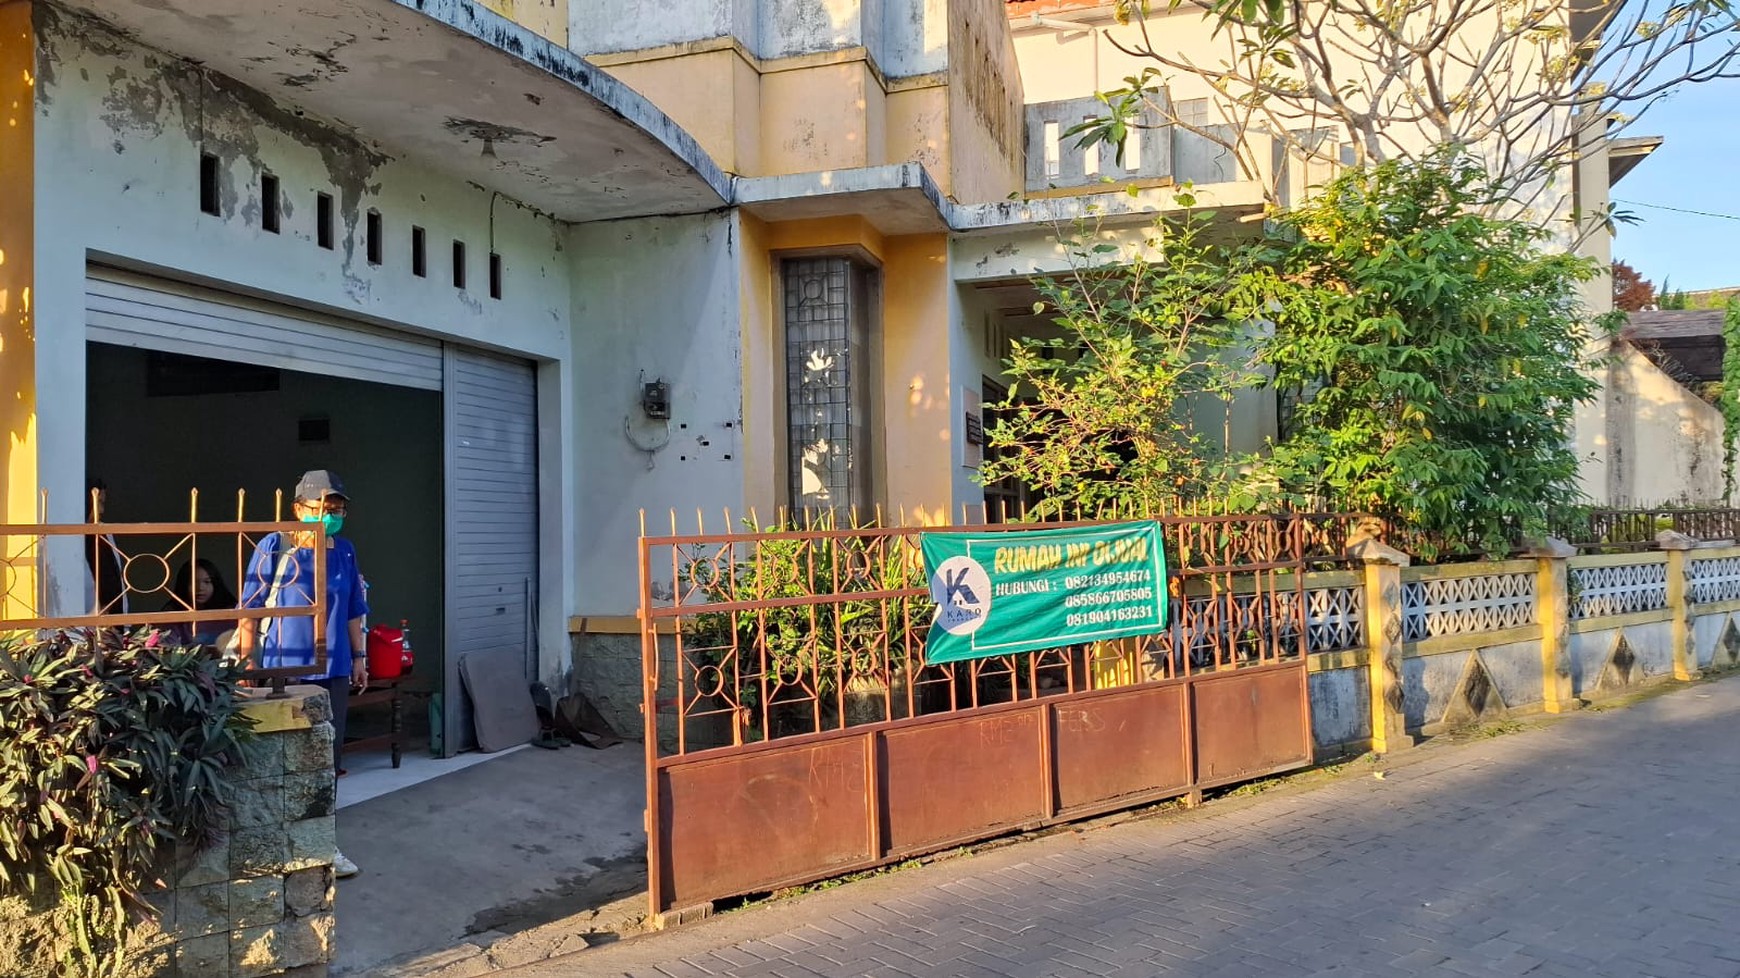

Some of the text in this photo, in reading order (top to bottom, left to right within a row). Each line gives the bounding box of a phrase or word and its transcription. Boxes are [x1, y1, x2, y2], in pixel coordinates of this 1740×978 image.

[994, 544, 1062, 574] RUMAH
[995, 578, 1050, 596] HUBUNGI
[1064, 569, 1151, 589] 082134954674
[1065, 587, 1152, 608] 085866705805
[1066, 605, 1153, 627] 081904163231
